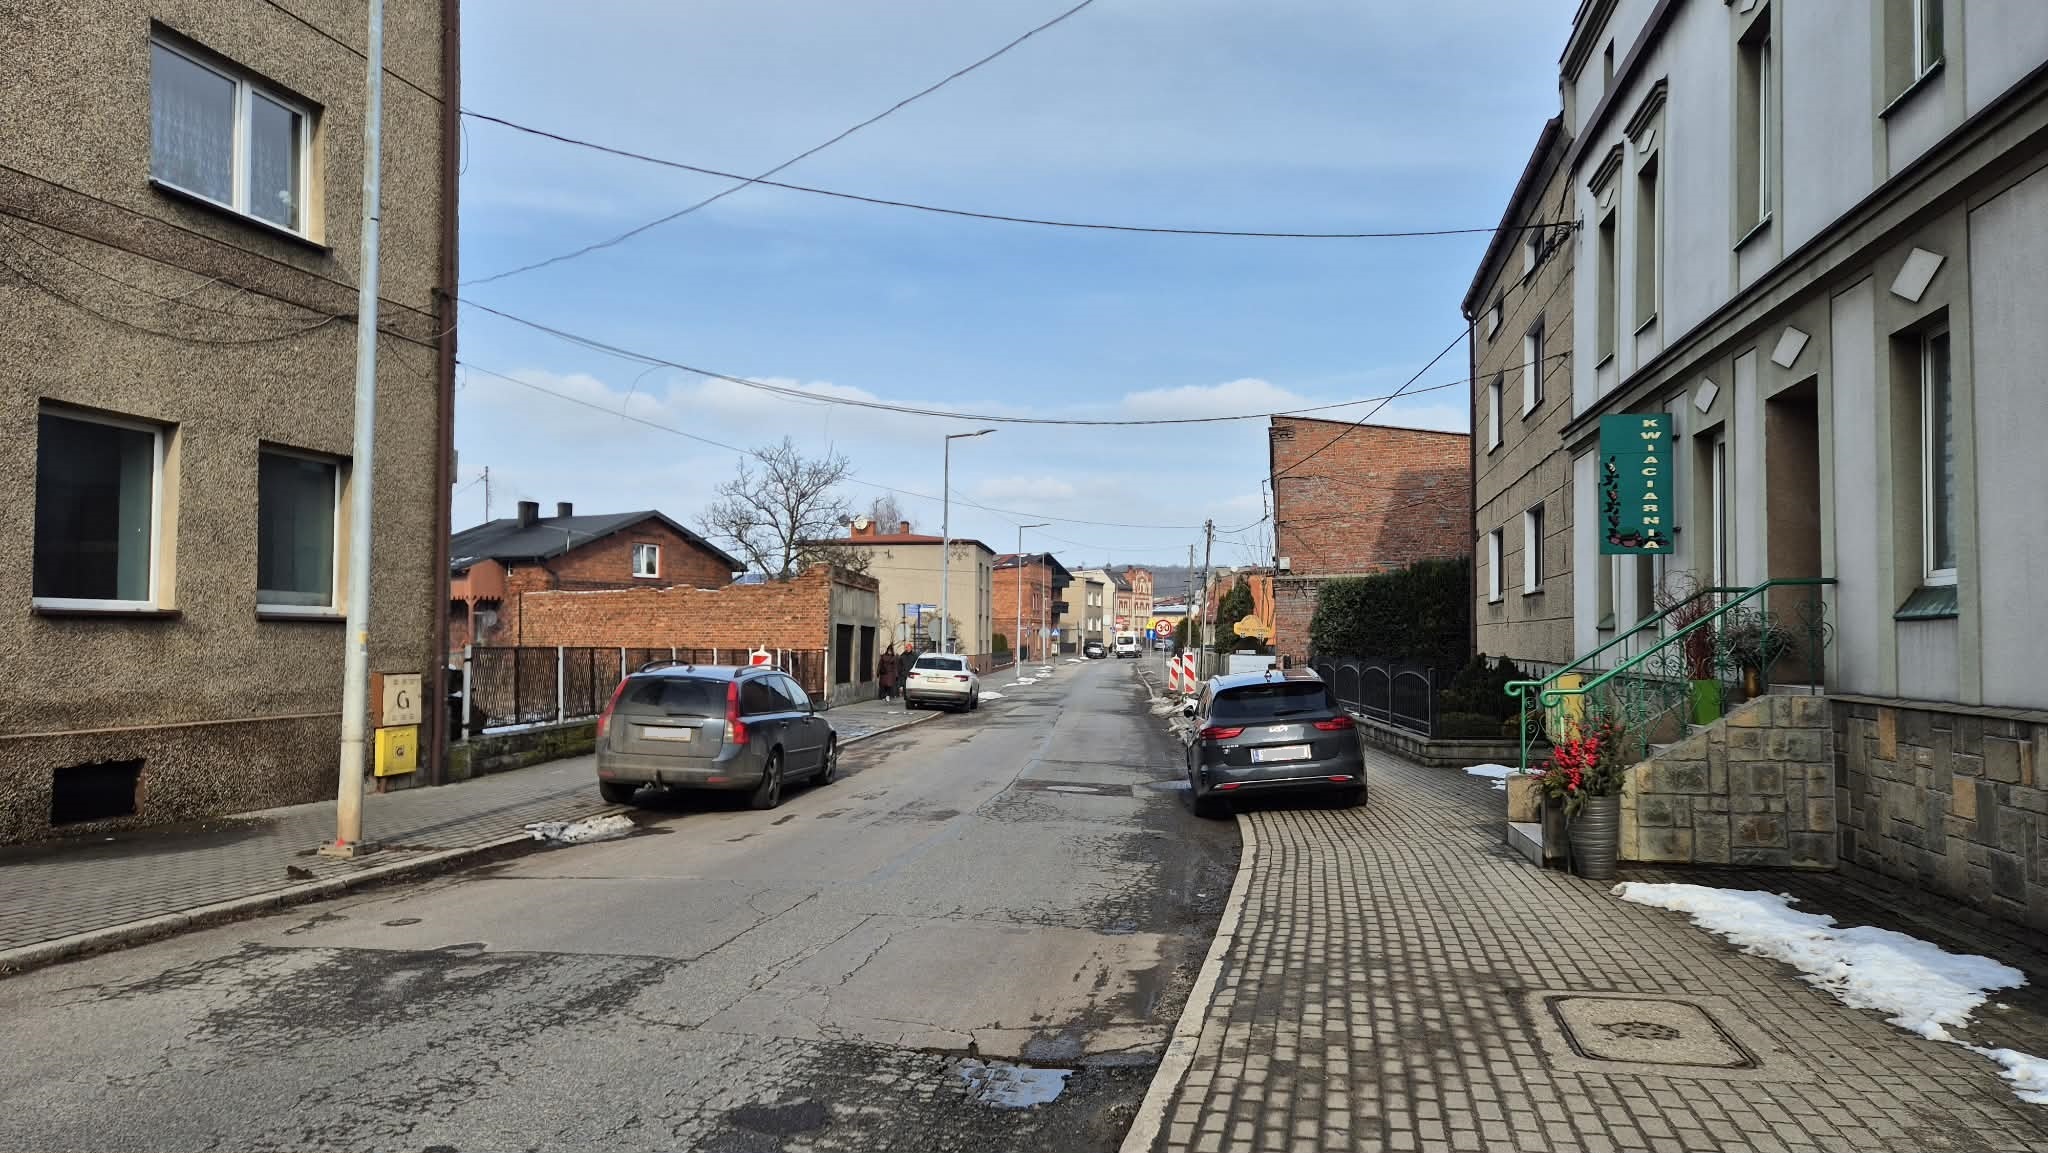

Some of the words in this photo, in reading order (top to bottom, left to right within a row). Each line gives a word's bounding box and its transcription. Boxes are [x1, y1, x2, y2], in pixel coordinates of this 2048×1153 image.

[1639, 419, 1662, 549] KWIACIARNIA
[1157, 623, 1170, 633] 30
[396, 690, 410, 710] G
